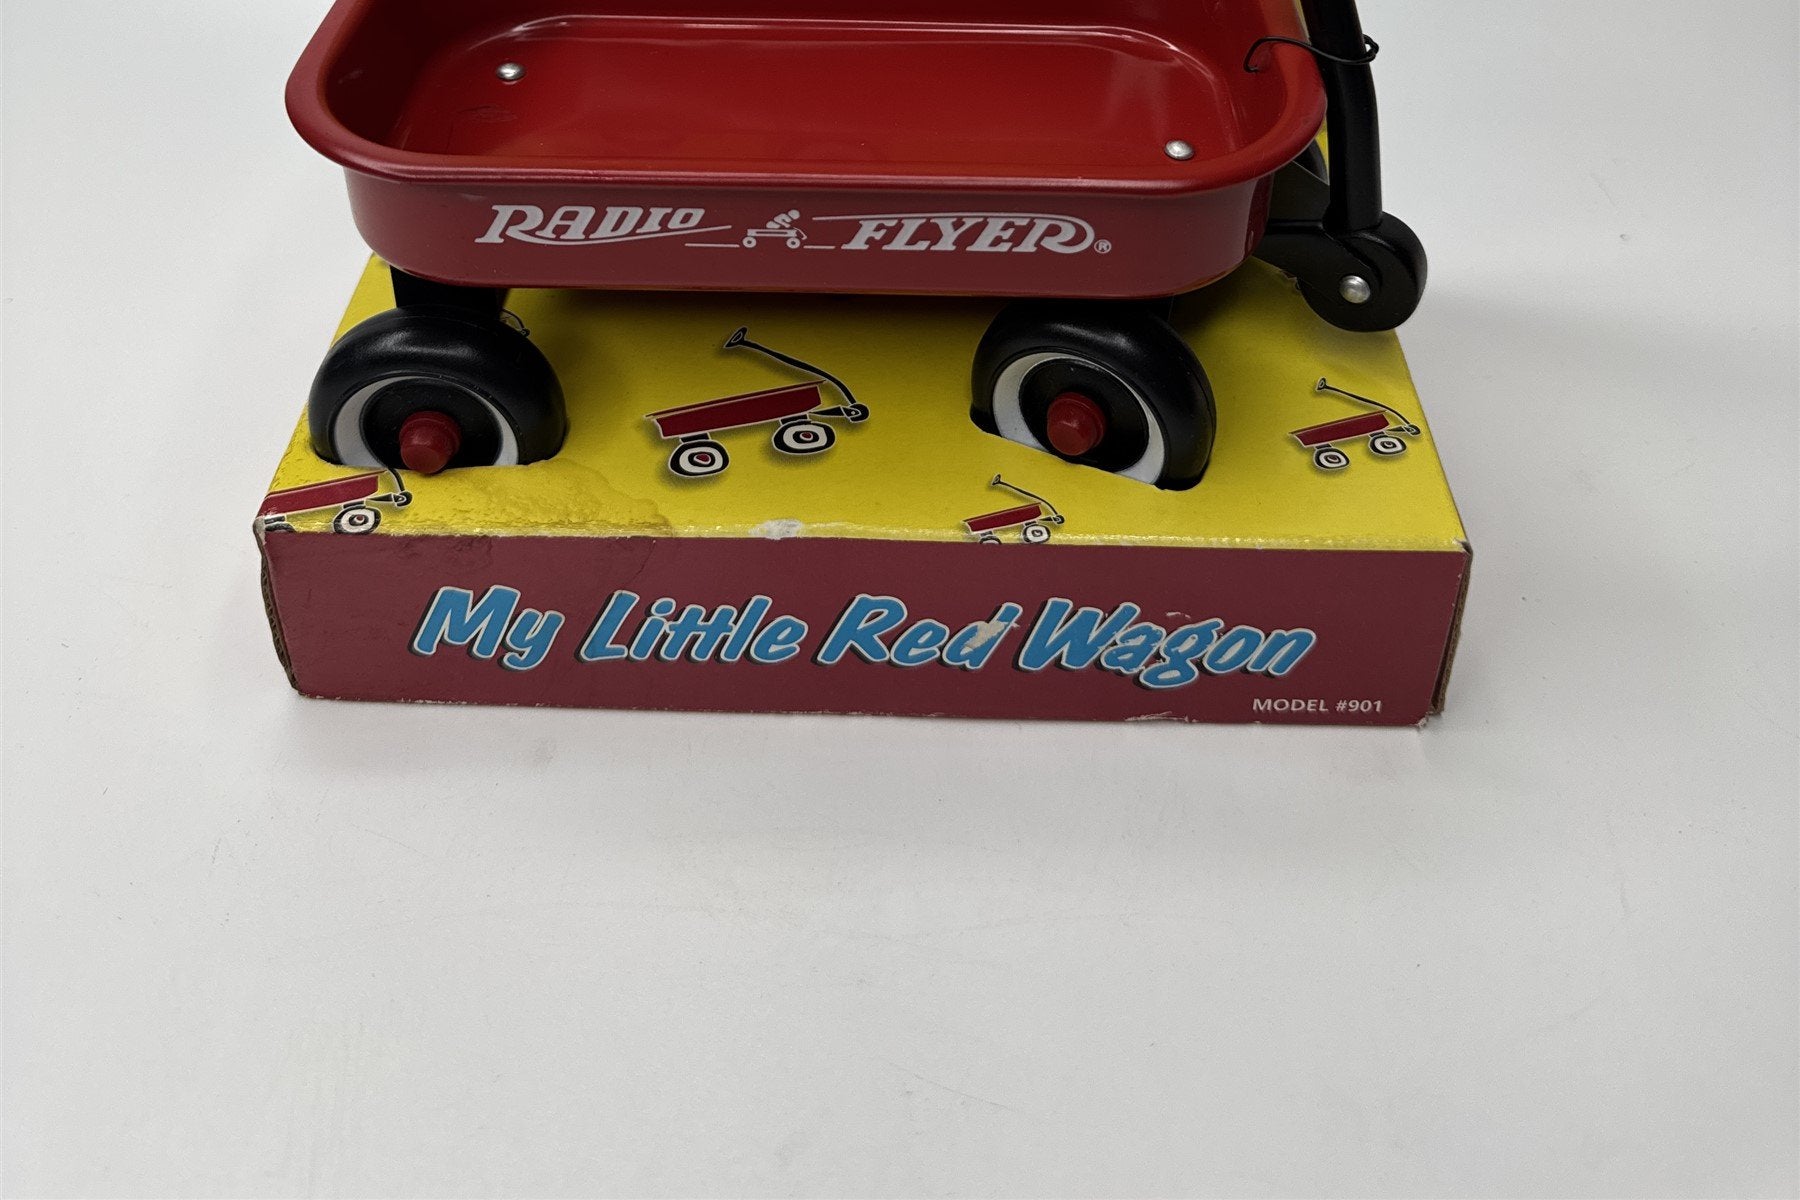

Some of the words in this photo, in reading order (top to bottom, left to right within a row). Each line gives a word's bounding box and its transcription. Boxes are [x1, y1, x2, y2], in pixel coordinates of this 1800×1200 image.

[475, 204, 733, 245] RADIO
[812, 212, 1097, 253] FLYER
[412, 584, 566, 671] My
[578, 589, 809, 662] Little
[815, 593, 1023, 668] Red
[1016, 596, 1318, 689] Wagon
[1252, 697, 1330, 713] MODEL
[1335, 698, 1384, 714] #901
